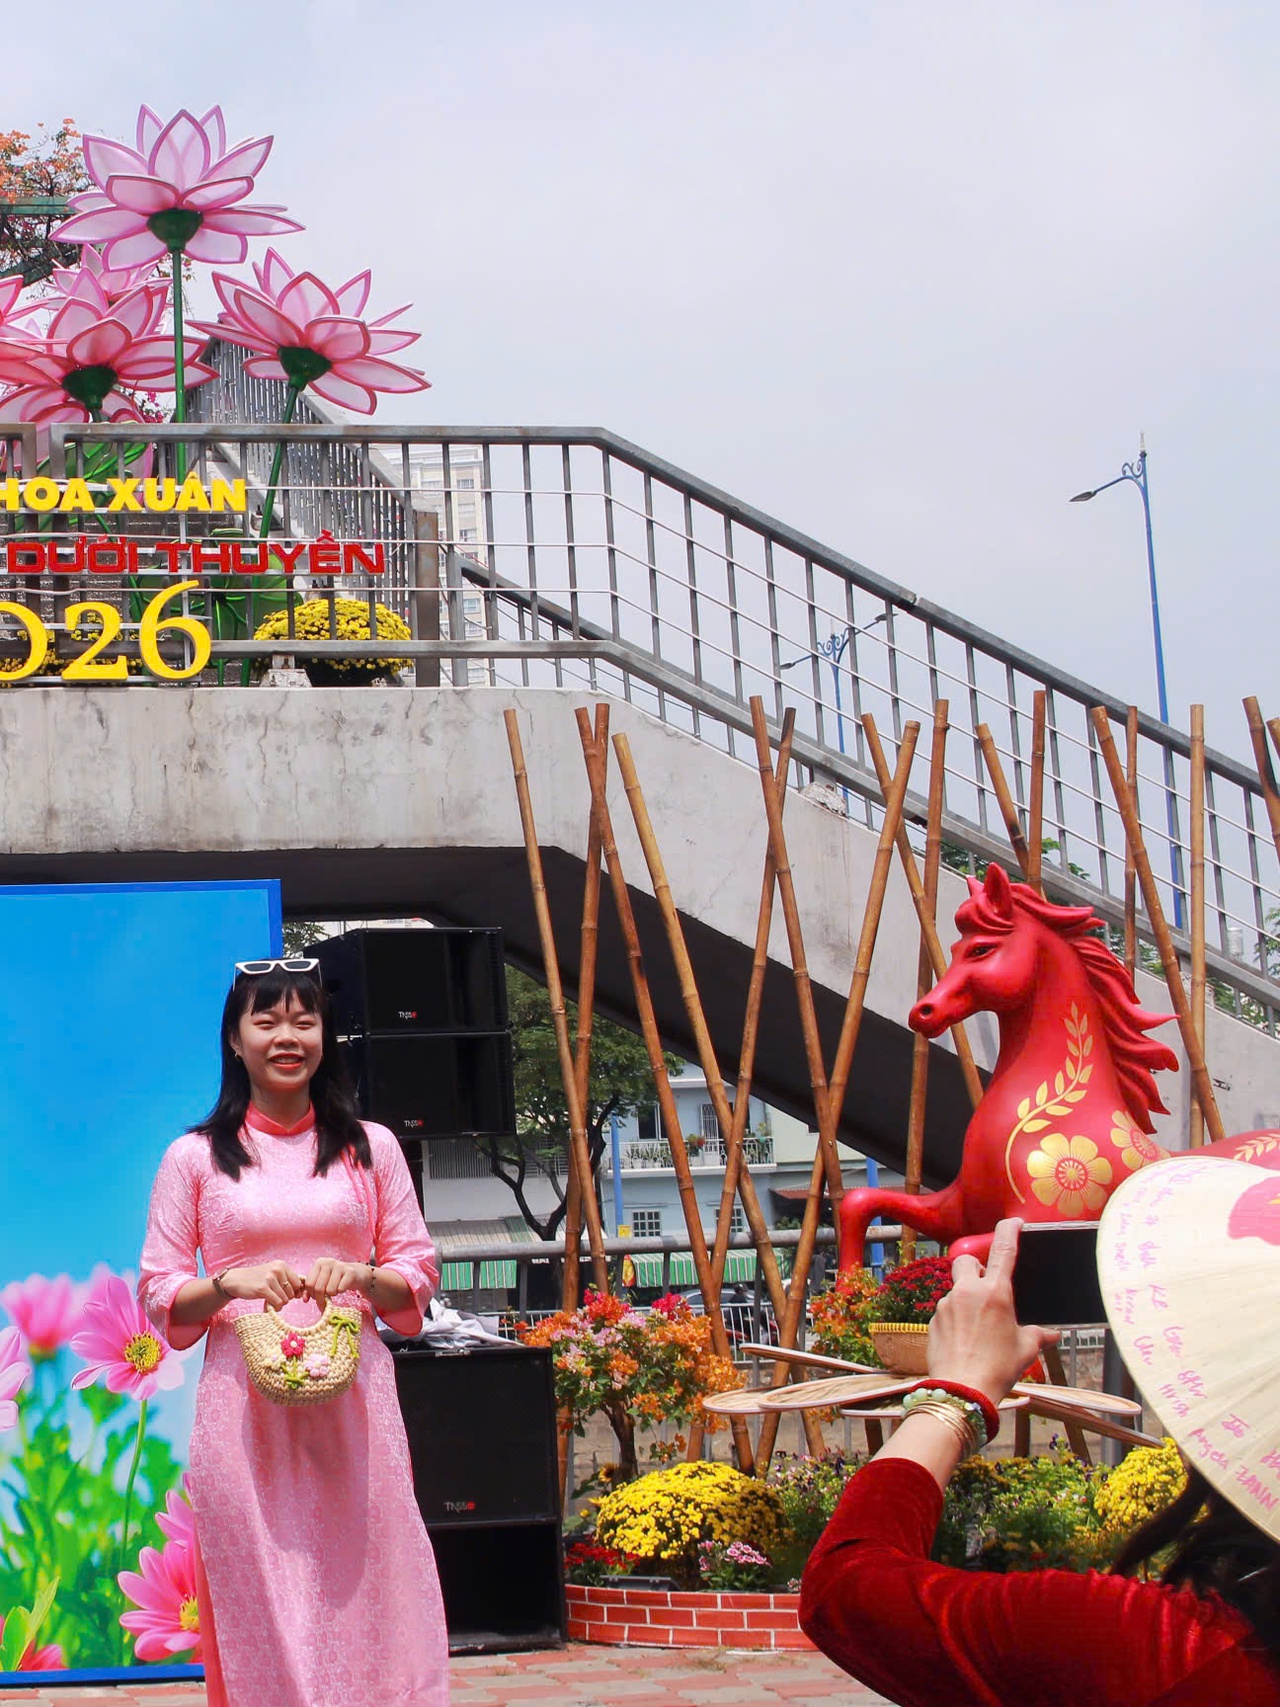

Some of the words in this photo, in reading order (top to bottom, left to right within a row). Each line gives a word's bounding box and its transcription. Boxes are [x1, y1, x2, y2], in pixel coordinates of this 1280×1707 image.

[106, 471, 247, 512] XUÂN
[6, 533, 139, 574] DƯỚI
[155, 529, 385, 574] THUYỀN
